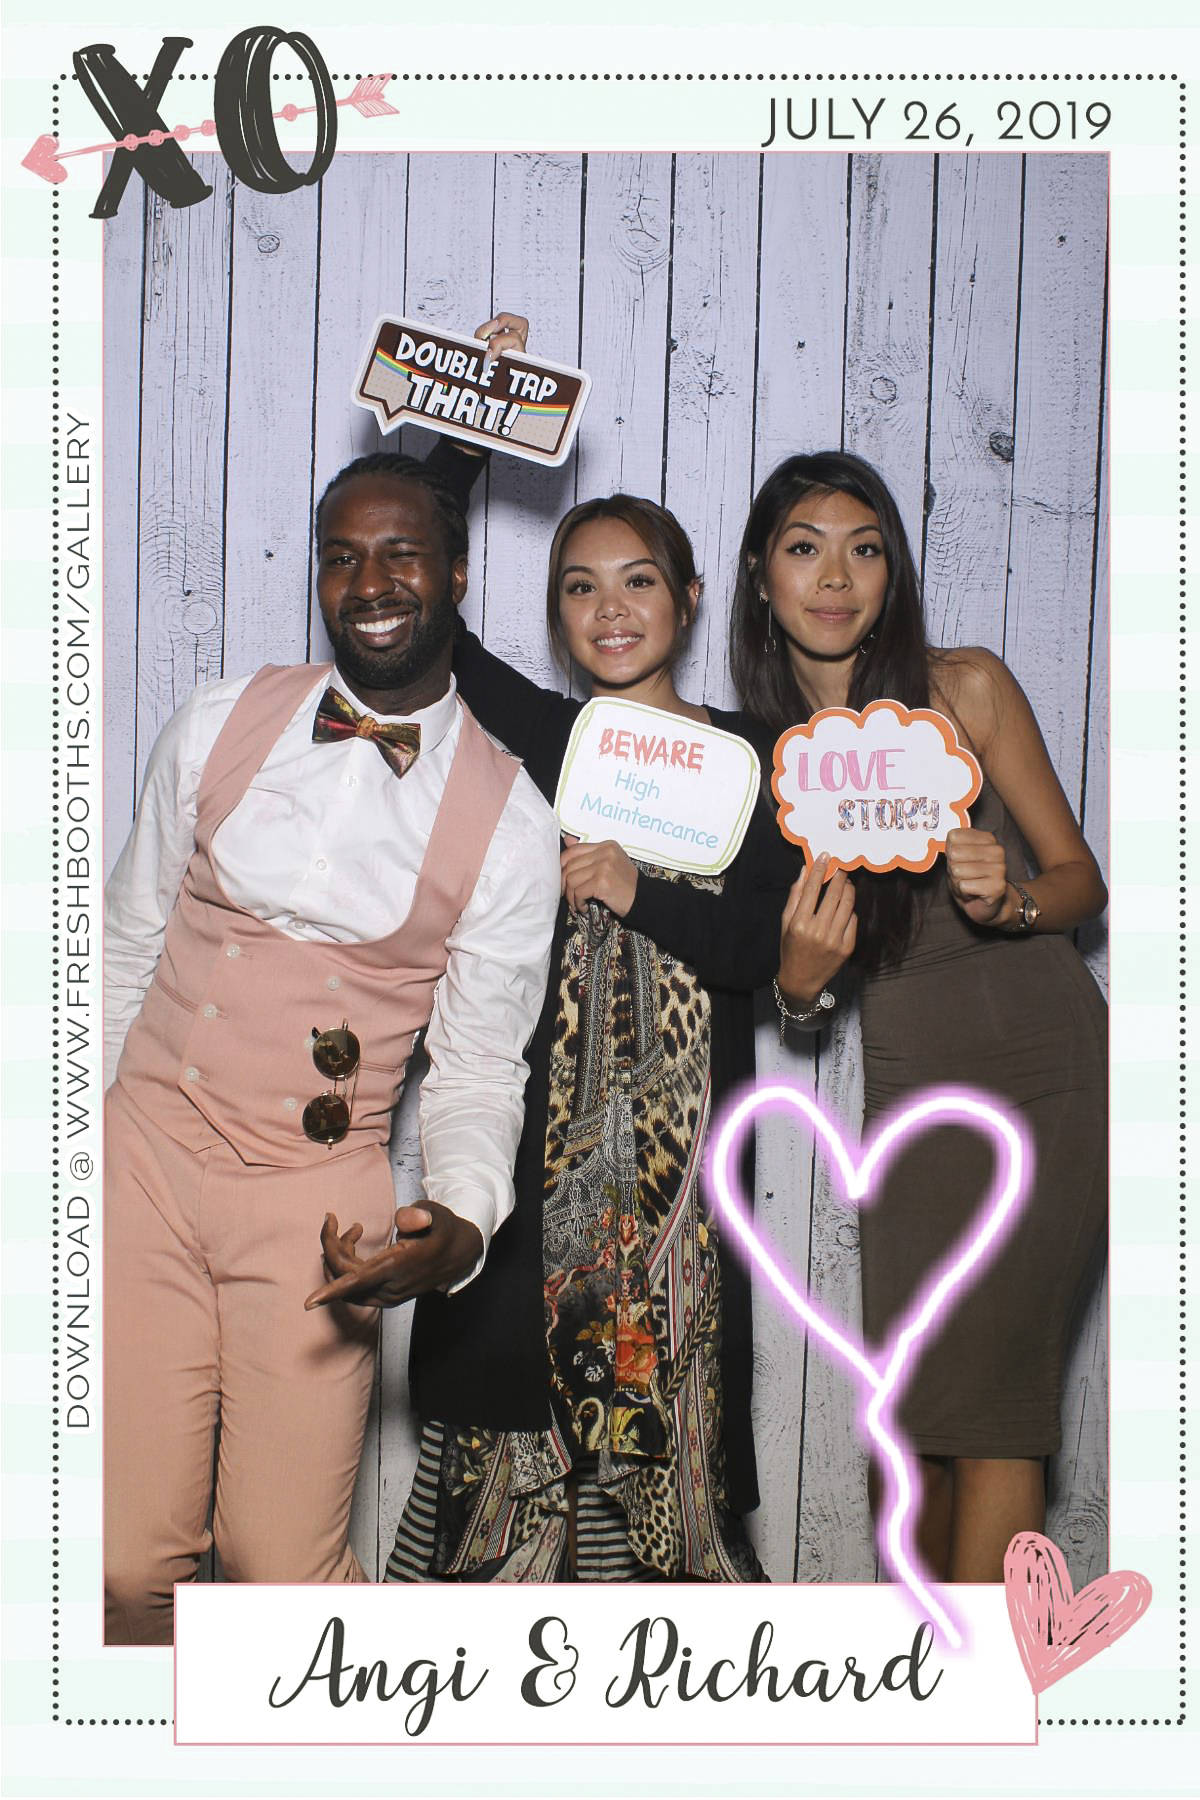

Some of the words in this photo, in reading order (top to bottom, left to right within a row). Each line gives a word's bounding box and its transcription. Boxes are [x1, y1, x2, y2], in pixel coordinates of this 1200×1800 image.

[395, 332, 499, 387] DOUBLE
[508, 368, 558, 402] TAP
[406, 371, 522, 436] THAT!
[598, 728, 705, 773] BEWARE
[798, 748, 906, 793] LOVE
[614, 769, 661, 801] High
[579, 792, 719, 849] Maintencance
